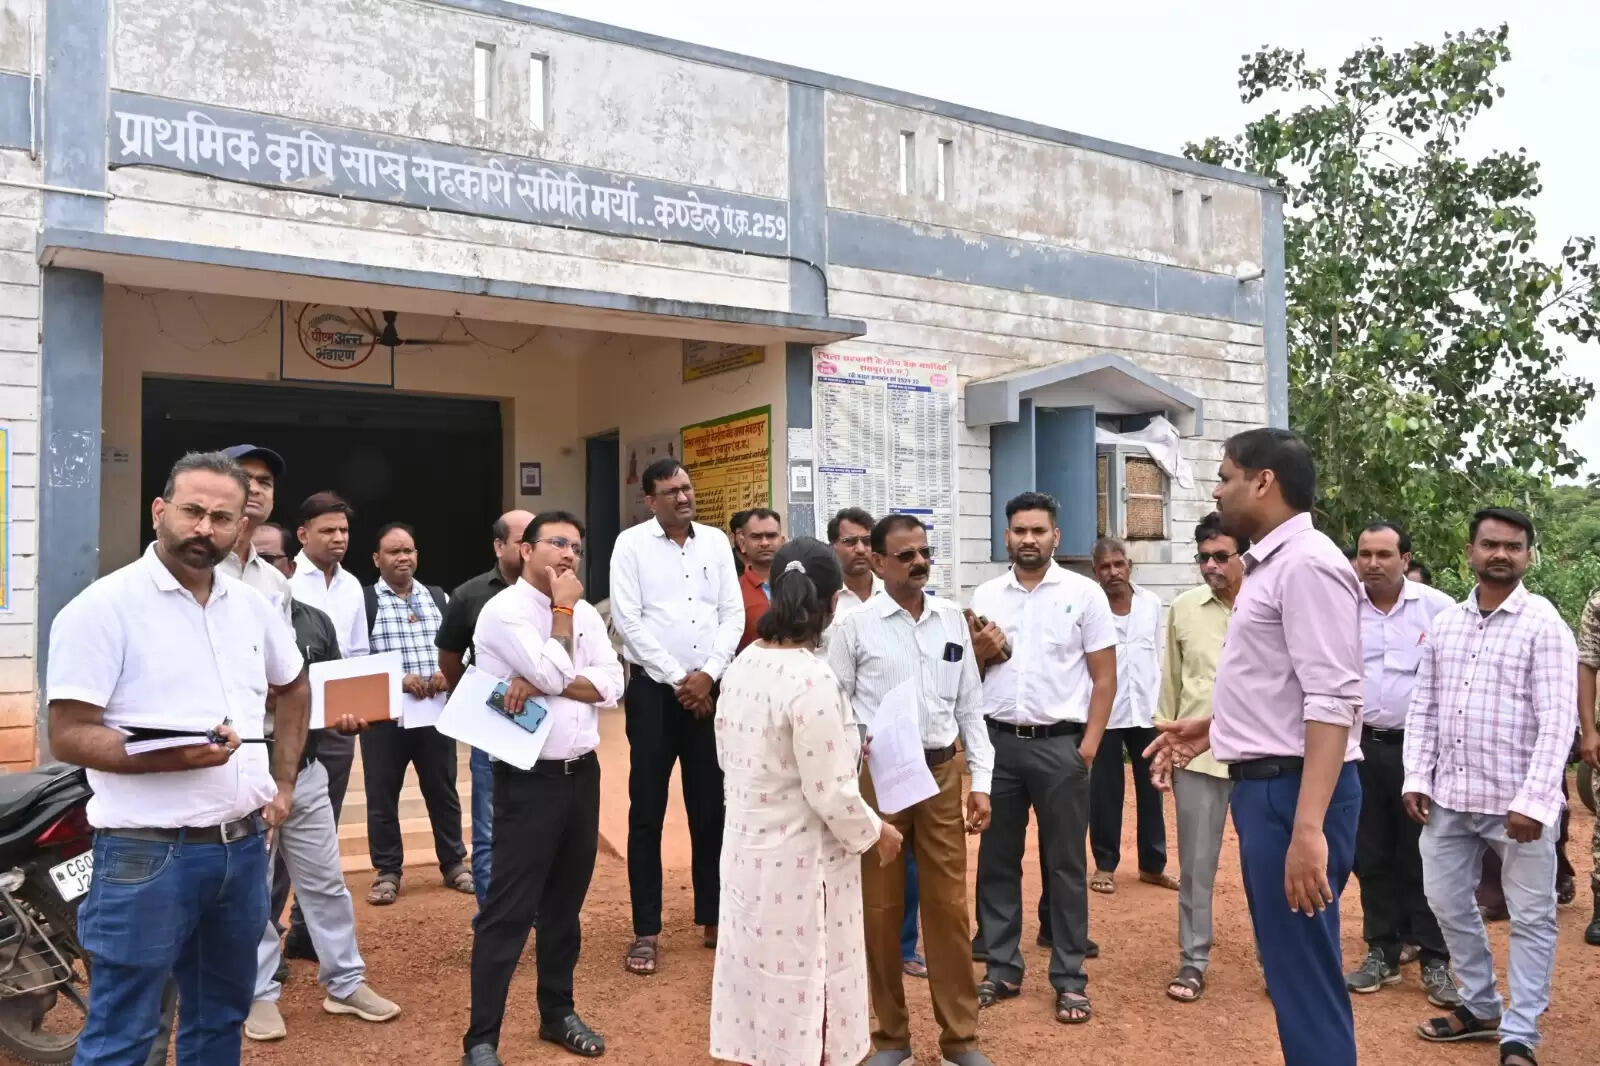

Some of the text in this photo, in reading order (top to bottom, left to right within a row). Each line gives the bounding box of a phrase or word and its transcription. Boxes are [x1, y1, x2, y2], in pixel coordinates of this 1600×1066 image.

[114, 110, 260, 171] प्राथमिक
[265, 130, 335, 183] कृषि
[340, 144, 408, 191] साख
[411, 157, 511, 208] सहकारी
[516, 167, 589, 221] समिति
[653, 190, 721, 240] कण्डेल
